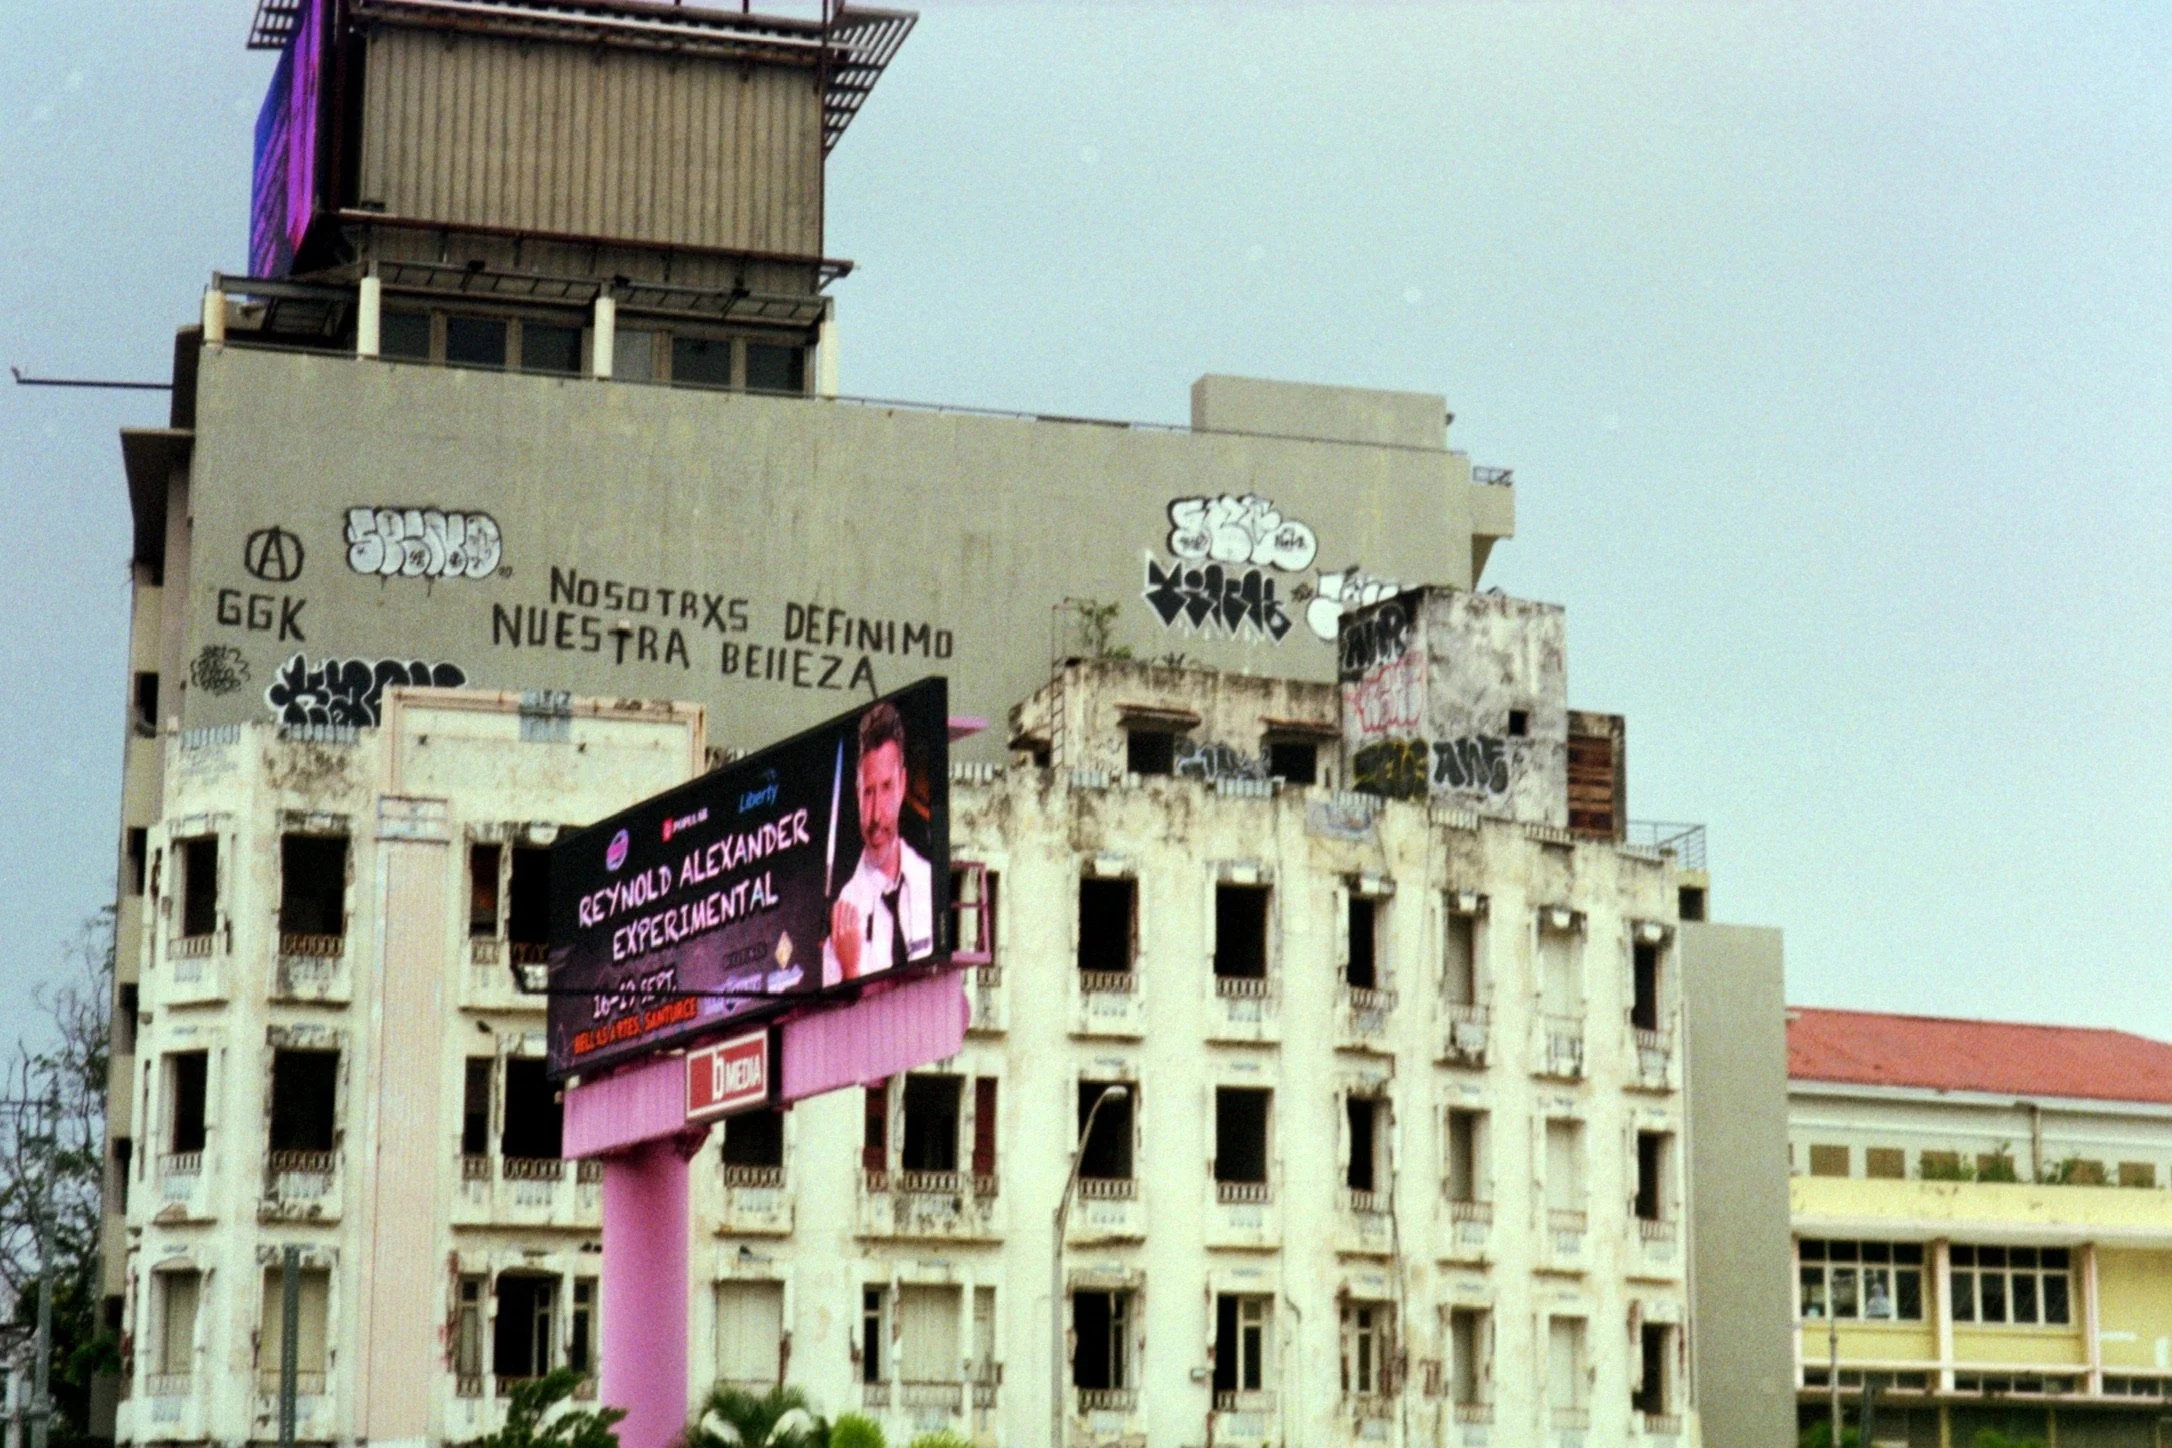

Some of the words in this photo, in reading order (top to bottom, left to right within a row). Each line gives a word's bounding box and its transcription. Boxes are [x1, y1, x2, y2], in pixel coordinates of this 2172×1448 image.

[216, 588, 307, 642] GGK
[550, 565, 750, 633] NOSOTRXS
[493, 603, 691, 670] NUESTRA
[579, 865, 672, 928] REYNOLD
[679, 808, 810, 889] ALEXANDER
[613, 870, 779, 961] EXPERIMENTAL
